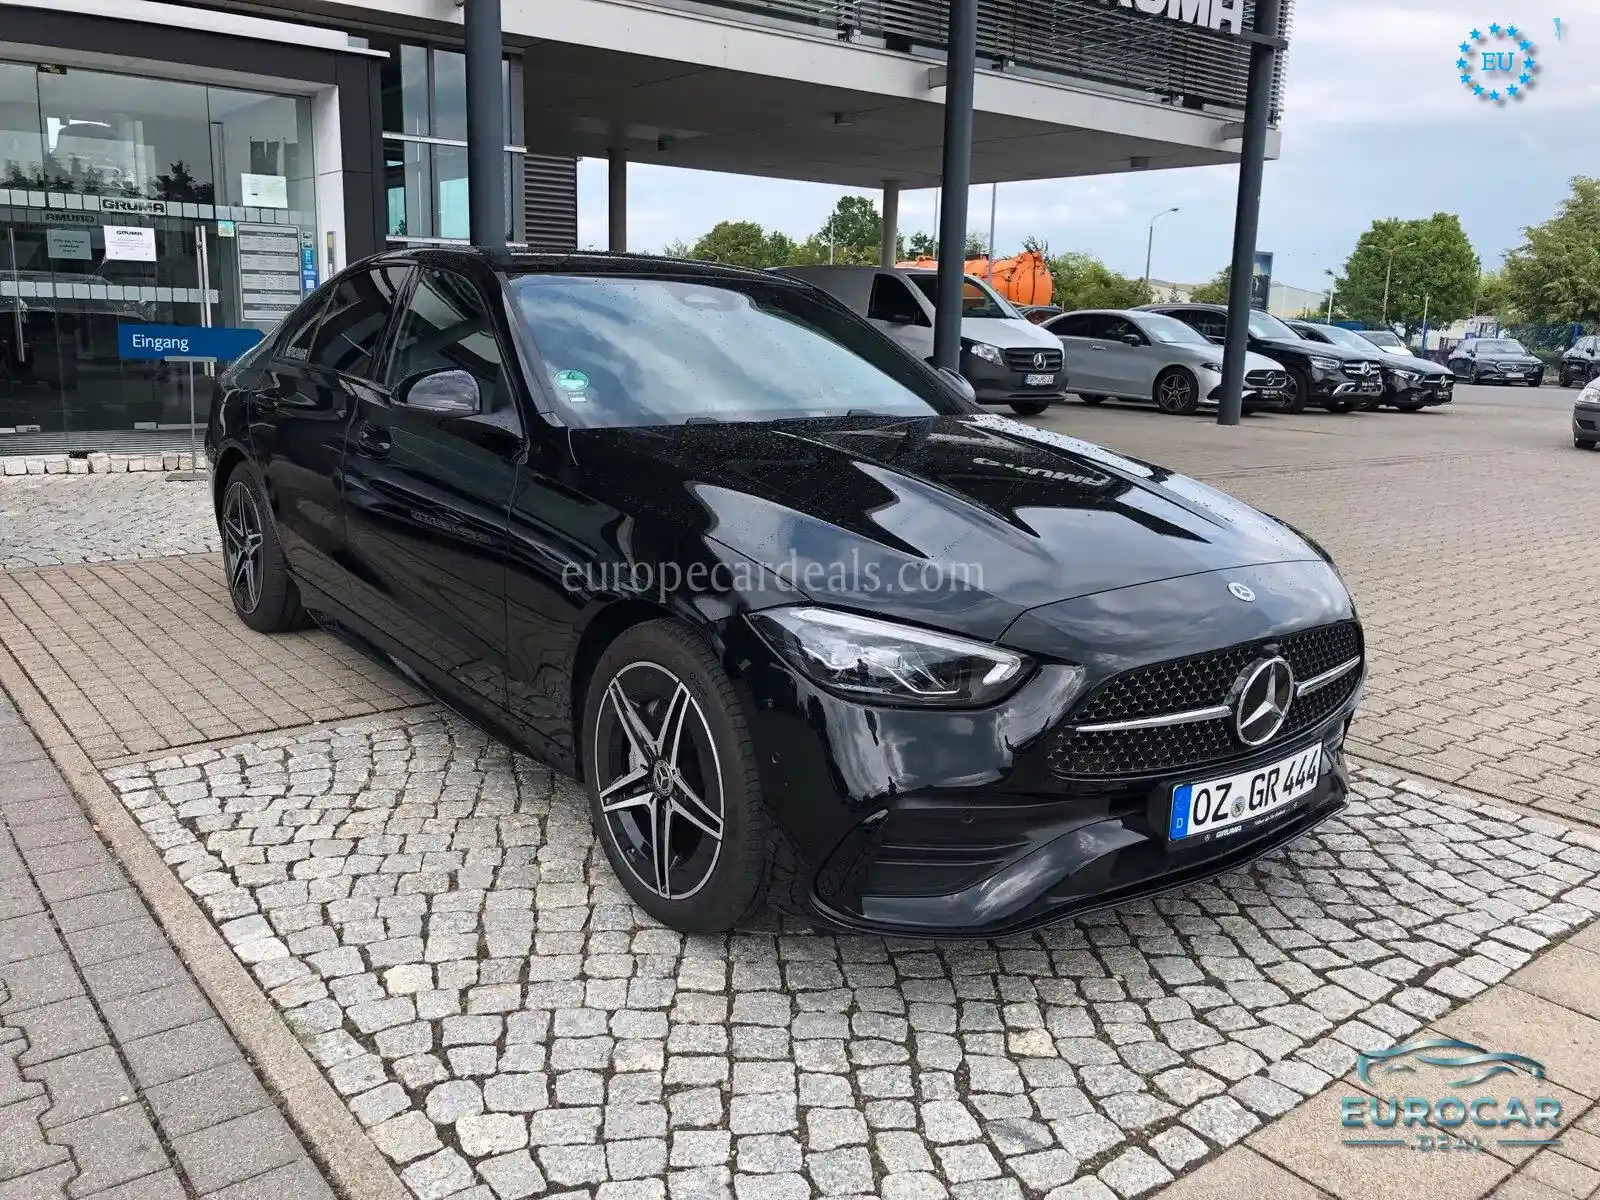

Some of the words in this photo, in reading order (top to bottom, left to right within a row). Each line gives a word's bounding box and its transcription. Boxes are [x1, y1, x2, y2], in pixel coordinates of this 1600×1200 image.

[102, 199, 165, 213] GRUMA
[132, 334, 189, 351] Eingang
[1193, 782, 1233, 827] OZ
[1249, 767, 1281, 811] GR
[1283, 750, 1318, 796] 444
[1176, 818, 1184, 829] D
